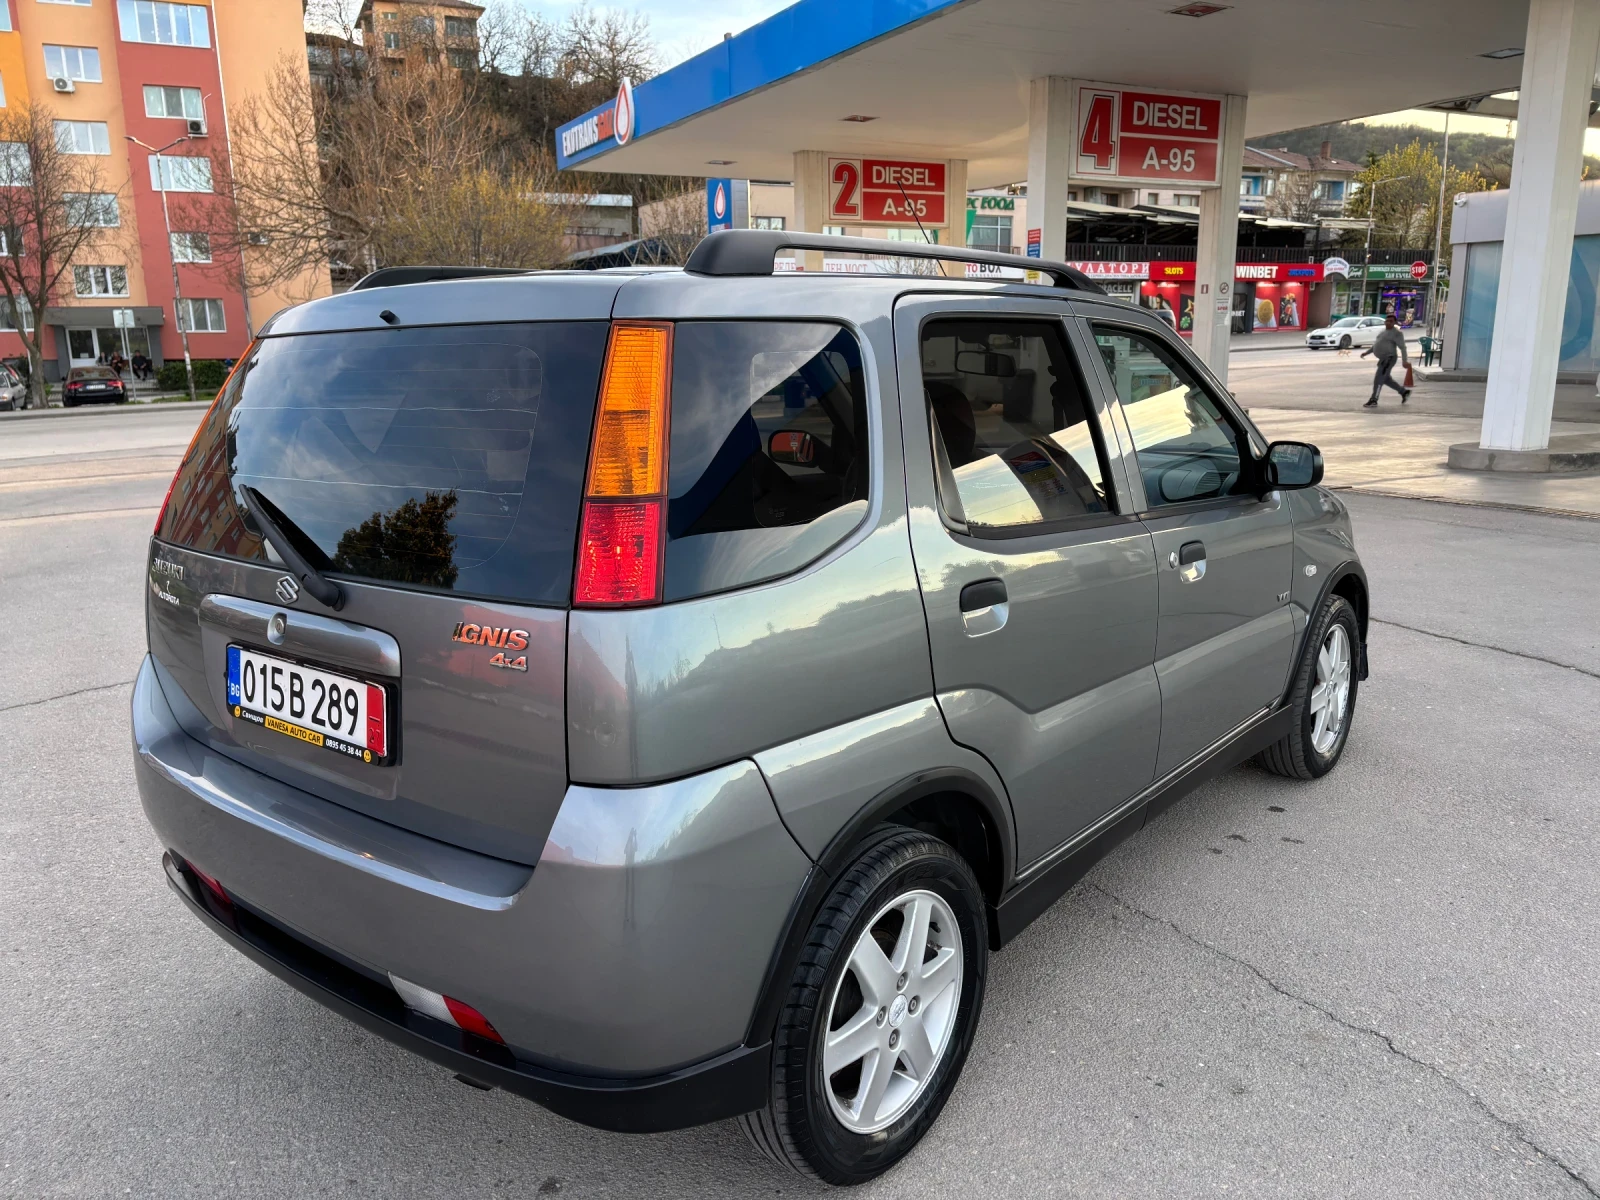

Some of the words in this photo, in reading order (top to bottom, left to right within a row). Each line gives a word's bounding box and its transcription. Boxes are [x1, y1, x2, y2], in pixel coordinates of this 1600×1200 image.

[1132, 101, 1208, 131] DIESEL
[1080, 94, 1115, 170] 4
[1141, 146, 1195, 173] A-95
[872, 165, 936, 187] DIESEL
[832, 161, 859, 217] 2
[882, 198, 927, 217] A-95
[980, 196, 1015, 211] ЕООД
[1164, 267, 1184, 275] SLOTS
[1235, 265, 1279, 279] WINBET
[1411, 266, 1426, 274] STOP
[452, 621, 529, 651] IGNIS
[230, 682, 240, 697] BG
[267, 718, 289, 733] VANESA
[290, 727, 307, 739] AUTO
[308, 733, 321, 744] CAR
[325, 738, 339, 750] 0895
[340, 743, 347, 752] 45
[347, 745, 354, 755] 38
[355, 749, 362, 757] 44
